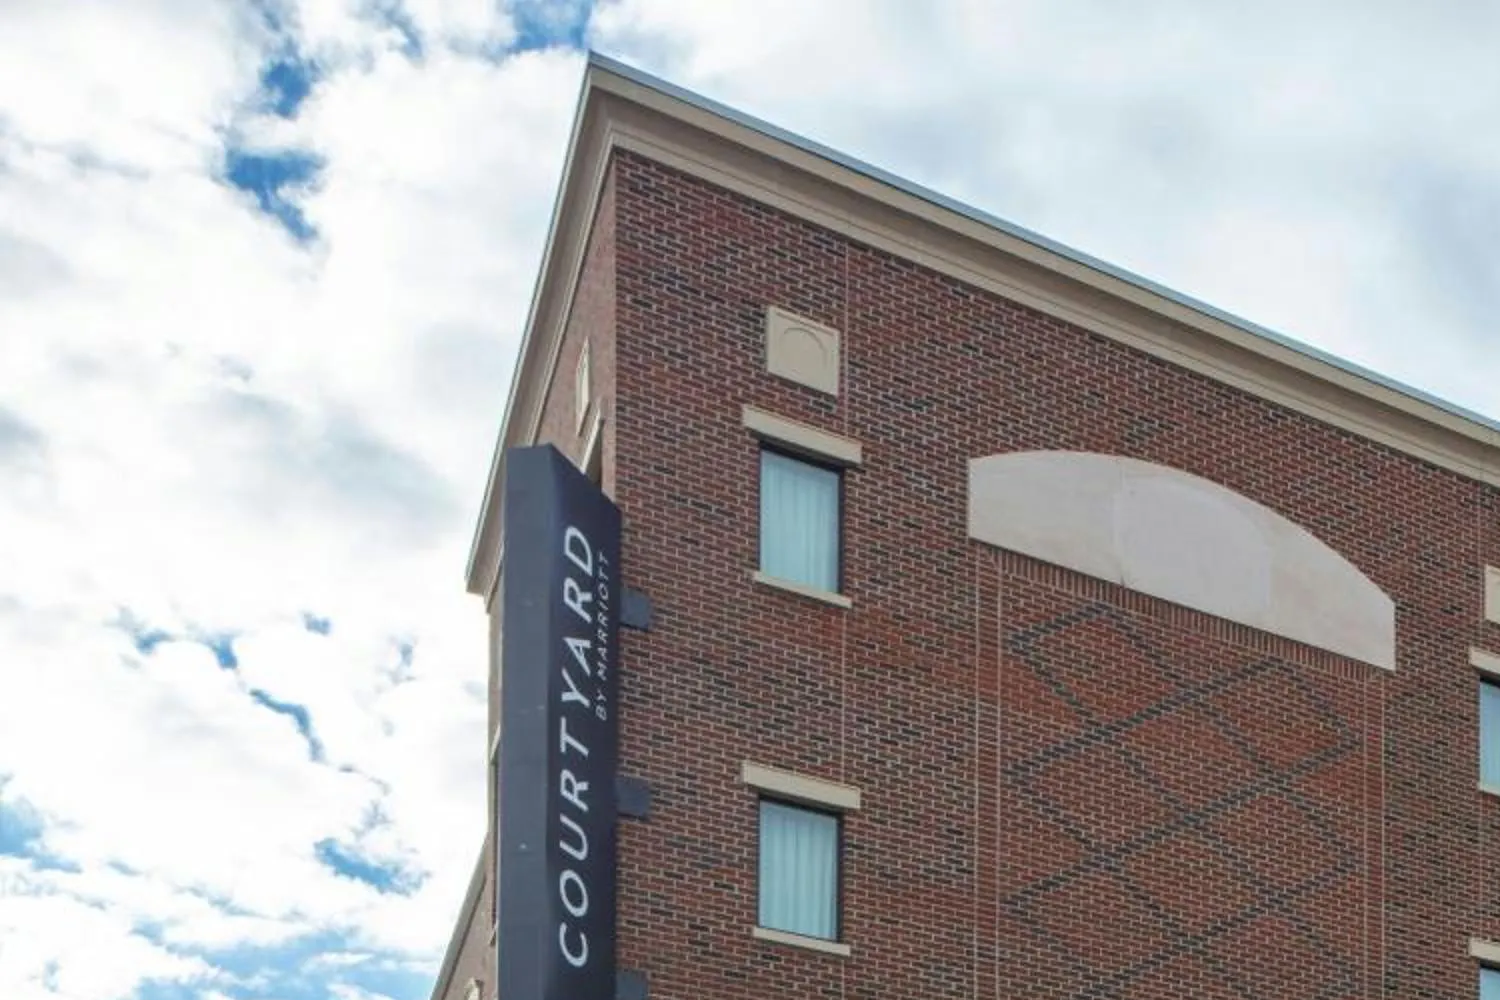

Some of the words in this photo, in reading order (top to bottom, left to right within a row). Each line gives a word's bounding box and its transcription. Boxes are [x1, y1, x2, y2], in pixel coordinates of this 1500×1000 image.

[597, 551, 610, 681] MARRIOTT
[559, 525, 593, 968] COURTYARD
[595, 688, 608, 722] BY
